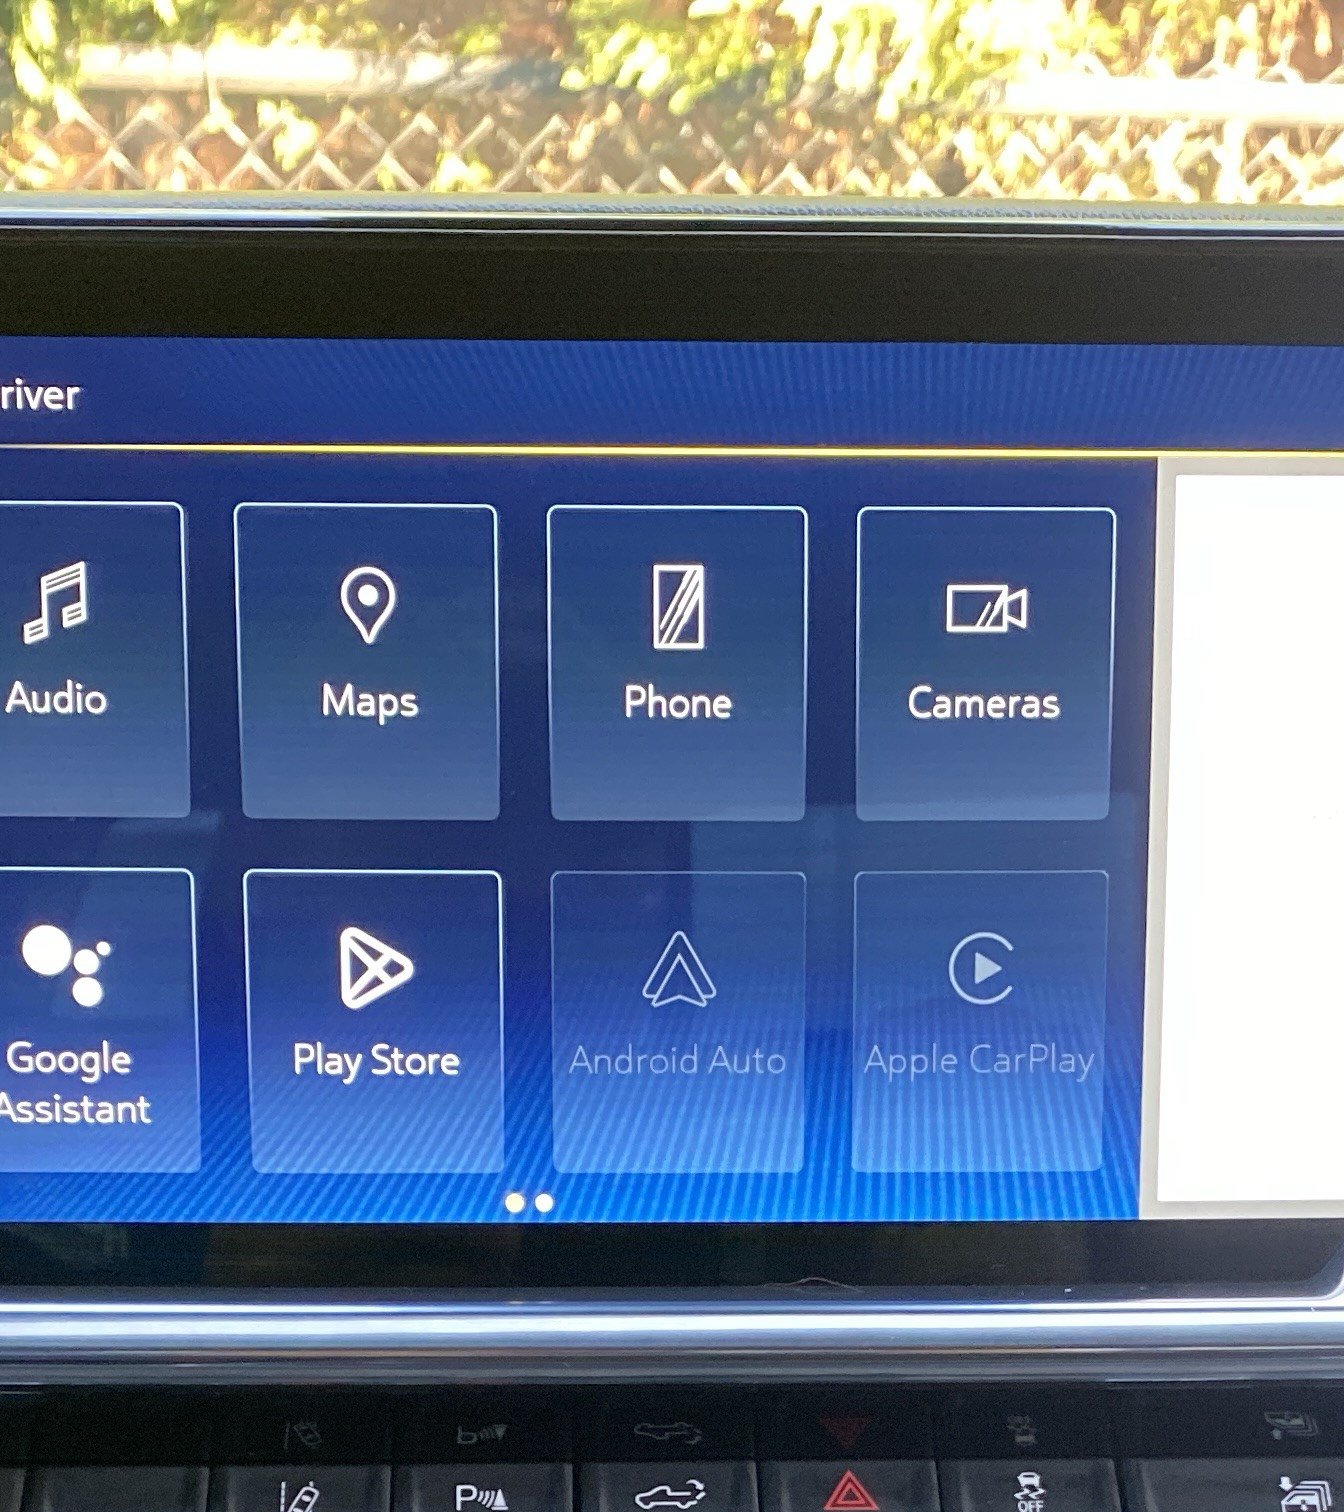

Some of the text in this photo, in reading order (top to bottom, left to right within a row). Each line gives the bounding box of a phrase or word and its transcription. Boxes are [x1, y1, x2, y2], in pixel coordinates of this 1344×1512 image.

[4, 679, 108, 715] Audio
[322, 682, 419, 726] Maps
[625, 683, 733, 719] Phone
[908, 685, 1061, 719] Cameras
[6, 1039, 132, 1084] Google
[294, 1041, 461, 1085] Play Store
[568, 1042, 787, 1076] Android Auto
[863, 1042, 1096, 1084] Apple CarPlay
